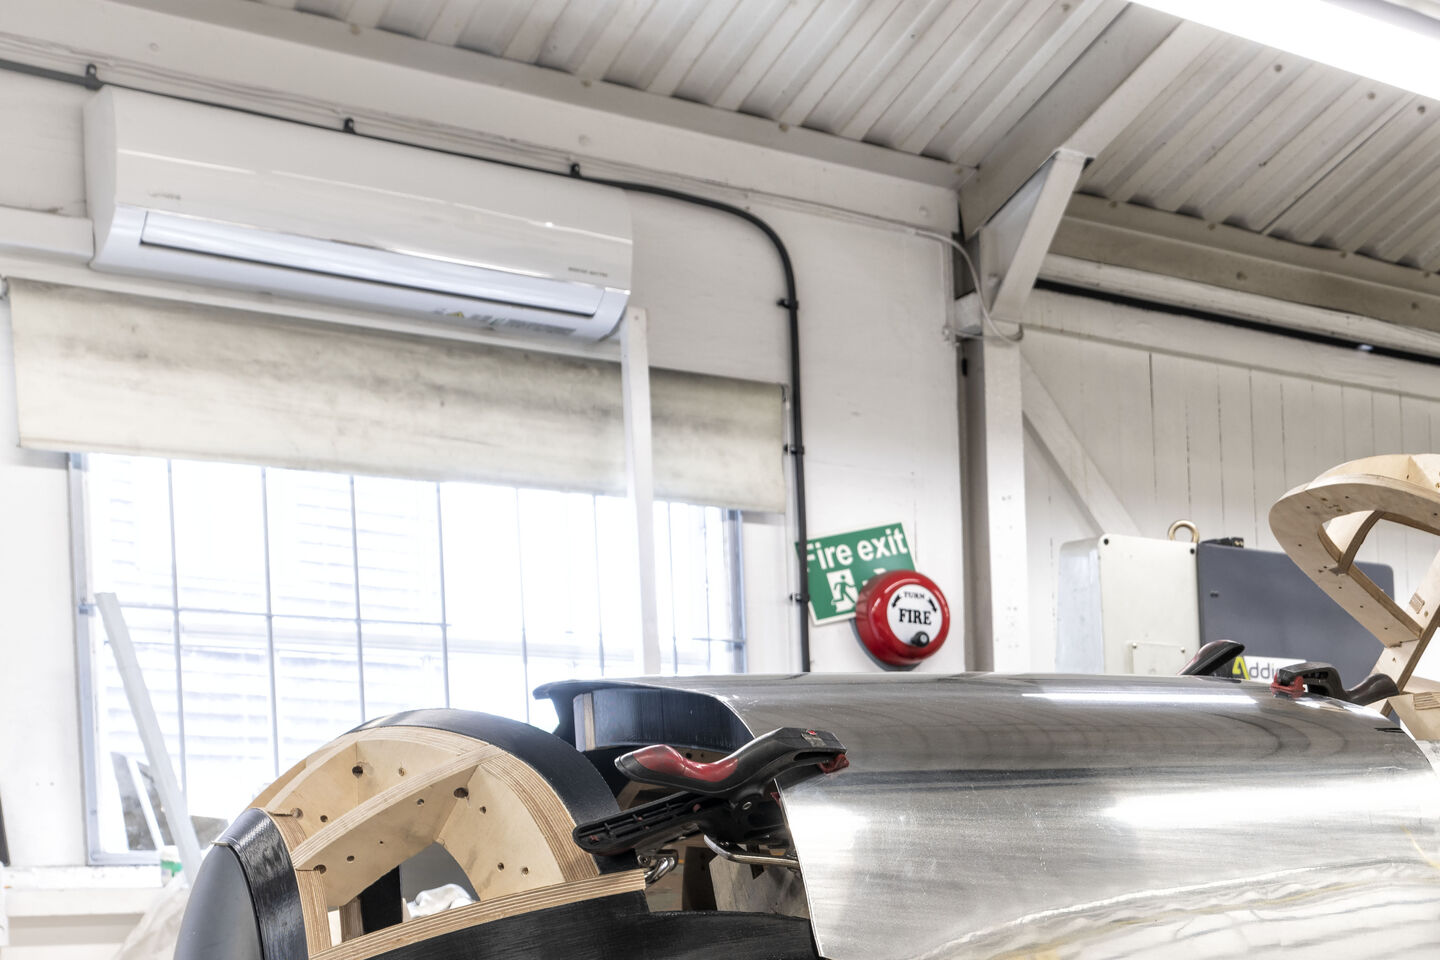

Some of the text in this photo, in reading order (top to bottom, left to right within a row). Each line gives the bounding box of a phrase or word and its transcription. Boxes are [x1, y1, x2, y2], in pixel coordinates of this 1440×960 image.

[857, 528, 908, 561] exit
[904, 591, 925, 599] TURN
[899, 608, 931, 625] FIRE
